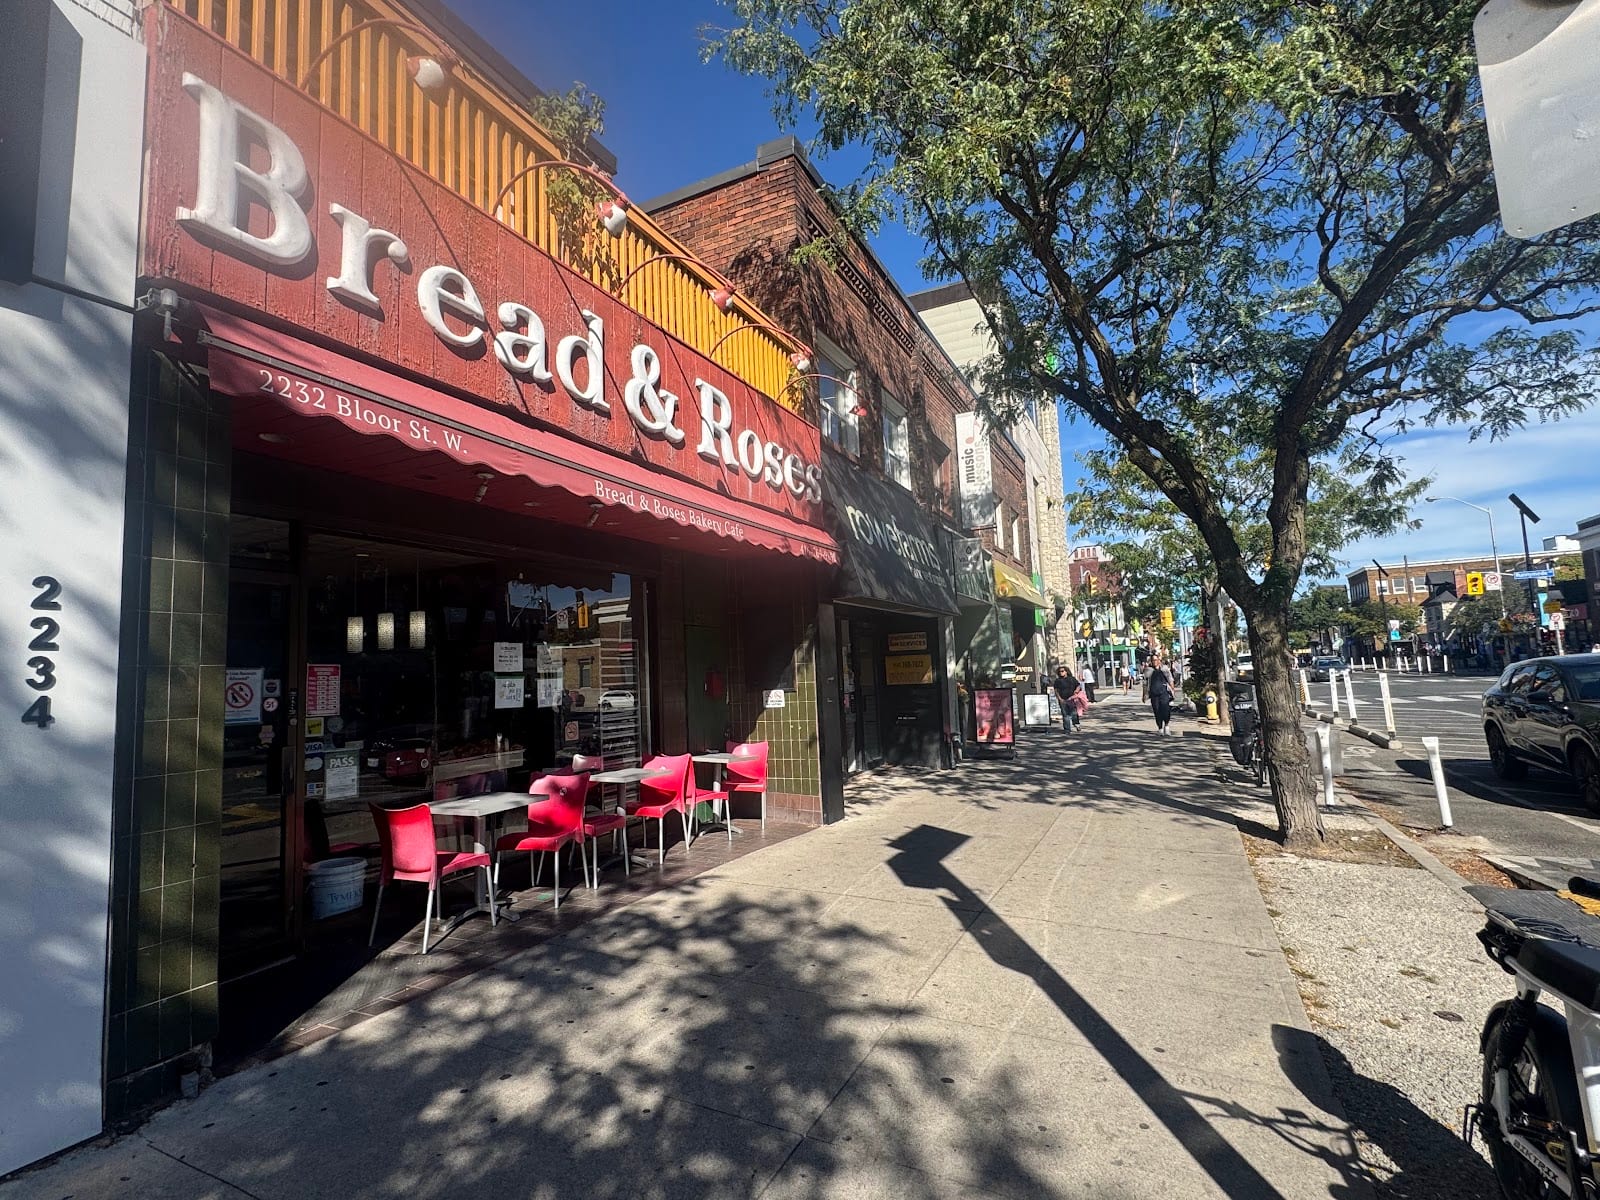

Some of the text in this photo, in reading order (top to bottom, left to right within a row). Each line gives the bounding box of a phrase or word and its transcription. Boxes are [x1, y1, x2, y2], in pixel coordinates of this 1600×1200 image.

[175, 71, 823, 505] Bread & Roses
[259, 369, 468, 454] 2232 Bloor St. W.
[961, 448, 976, 484] music
[594, 479, 745, 539] Bread & Roses Bakery Cafe
[21, 575, 62, 731] 2234
[304, 743, 323, 752] VISA
[329, 757, 355, 769] PASS
